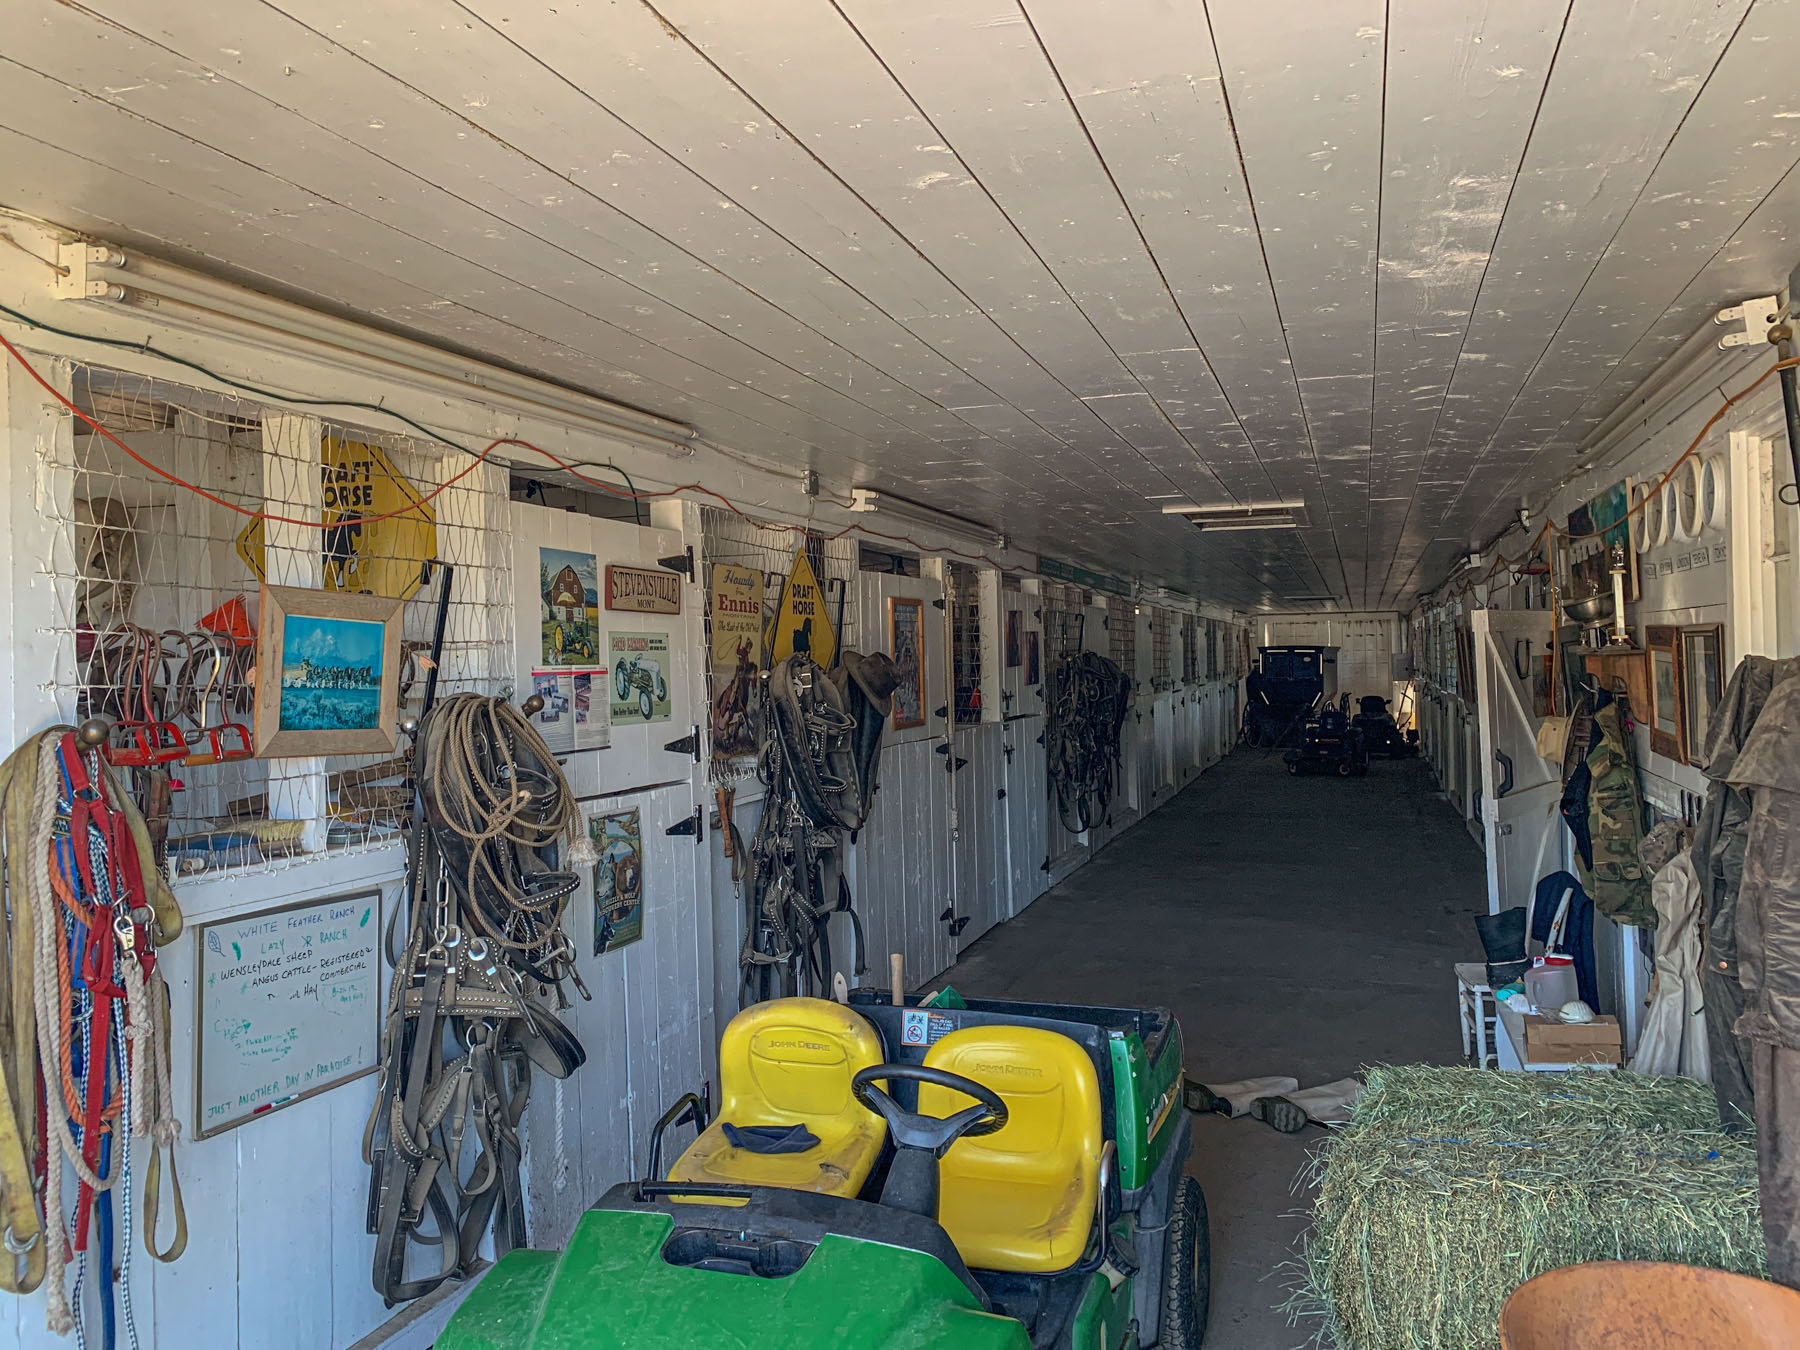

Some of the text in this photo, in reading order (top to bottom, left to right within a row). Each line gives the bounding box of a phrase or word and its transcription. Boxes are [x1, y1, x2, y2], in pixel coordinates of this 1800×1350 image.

[322, 461, 373, 482] RAFT
[323, 485, 373, 506] ORSE
[612, 570, 677, 604] STEVENSVILLE
[722, 568, 756, 590] Howdy
[792, 583, 814, 600] DRAFT
[637, 599, 656, 609] MONT
[718, 593, 759, 614] Ennis
[792, 600, 815, 616] HORSE
[238, 906, 355, 940] WHITE FEATHER RANCH
[261, 939, 285, 954] LAZY
[320, 928, 348, 944] RANCH
[220, 958, 281, 980] WENSLEYDALE
[252, 973, 279, 987] ANGUS
[320, 953, 364, 969] REGISTERED
[320, 962, 367, 982] COMMERCIAL
[303, 984, 319, 1001] HAY
[768, 1040, 830, 1052] JOHN DEERE
[972, 1063, 1042, 1078] JOHN DEERE
[208, 1101, 232, 1118] JUST
[238, 1081, 280, 1105] ANOTHER
[286, 1073, 300, 1088] DAY
[304, 1069, 314, 1081] IN
